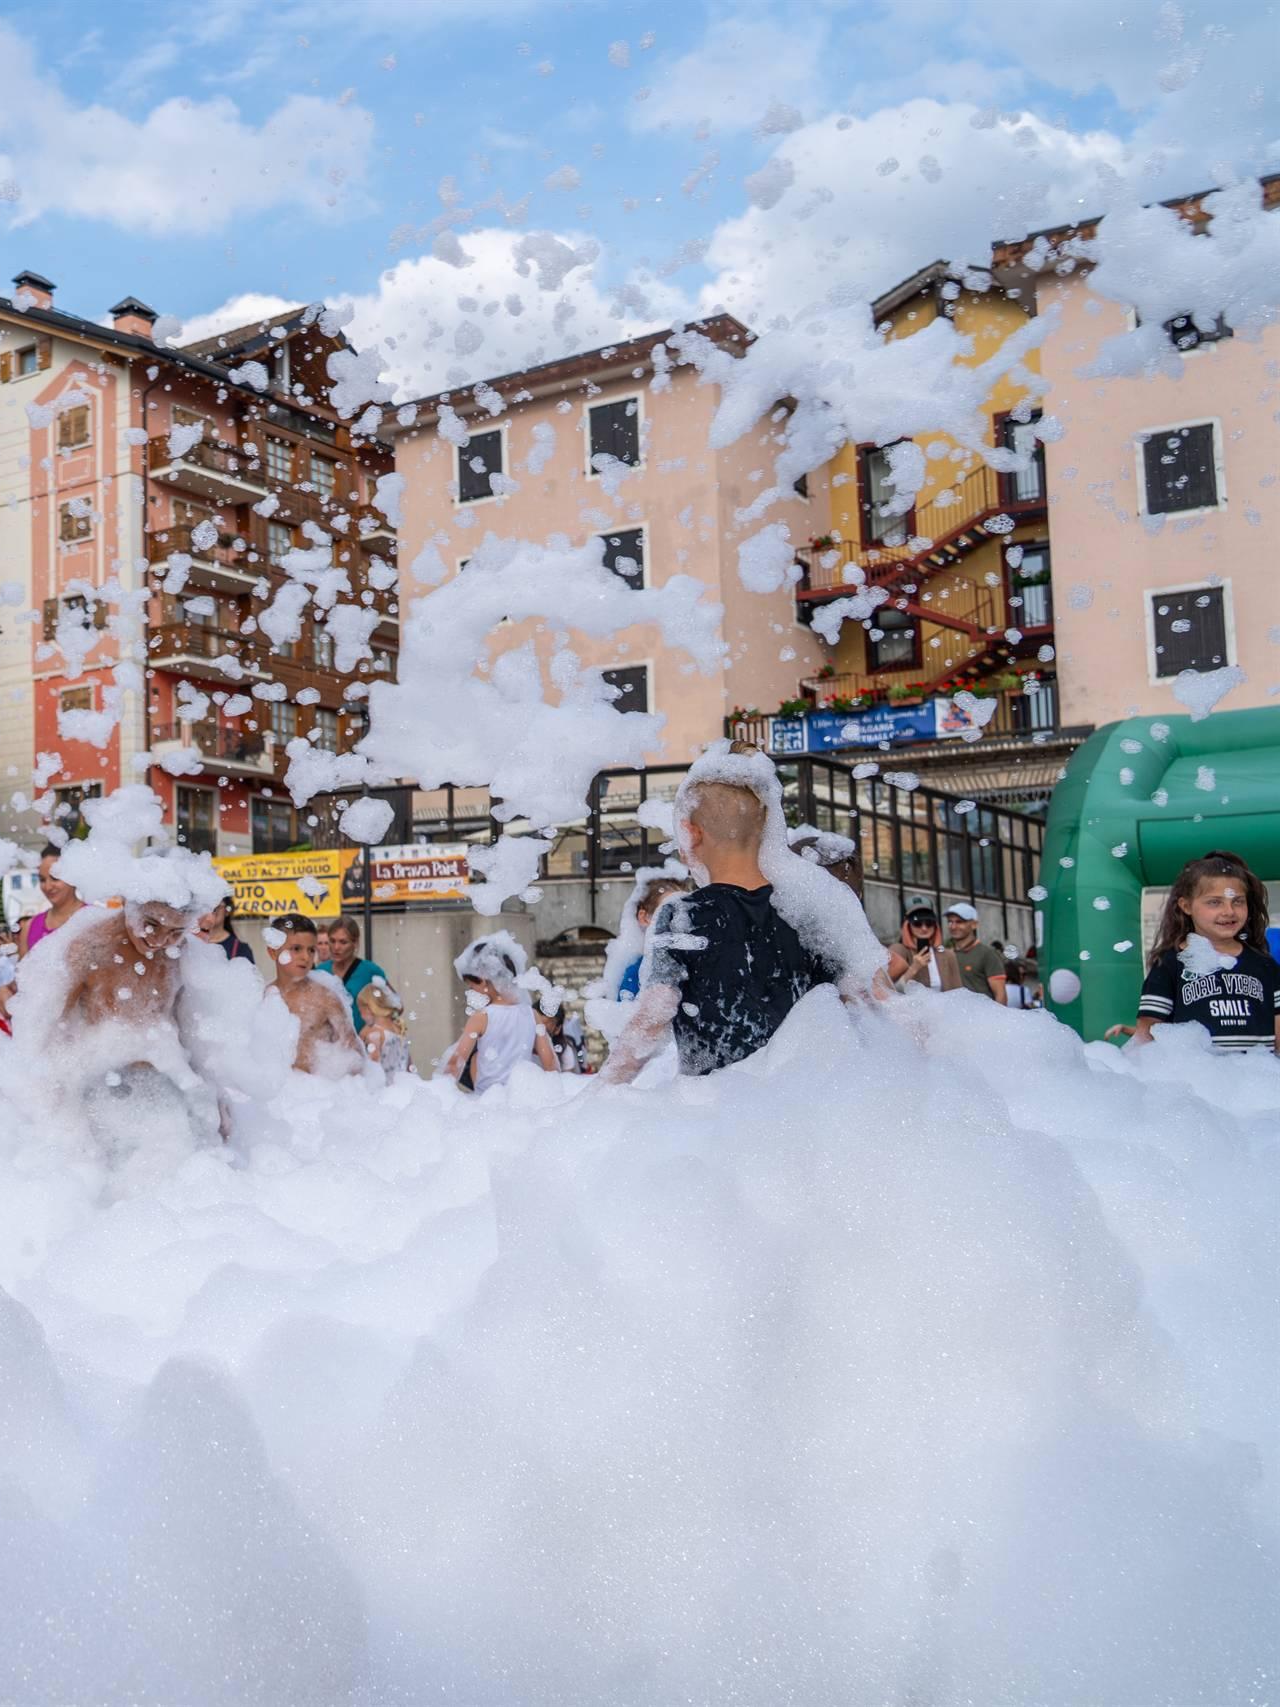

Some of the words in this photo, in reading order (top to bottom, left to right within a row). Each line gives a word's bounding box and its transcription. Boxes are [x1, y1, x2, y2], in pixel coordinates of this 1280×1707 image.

[223, 869, 242, 879] DAL
[261, 866, 274, 877] AL
[292, 864, 331, 875] LUGLIO
[376, 863, 392, 880] La
[1182, 974, 1222, 1005] GIRL
[1209, 999, 1252, 1017] SMILE
